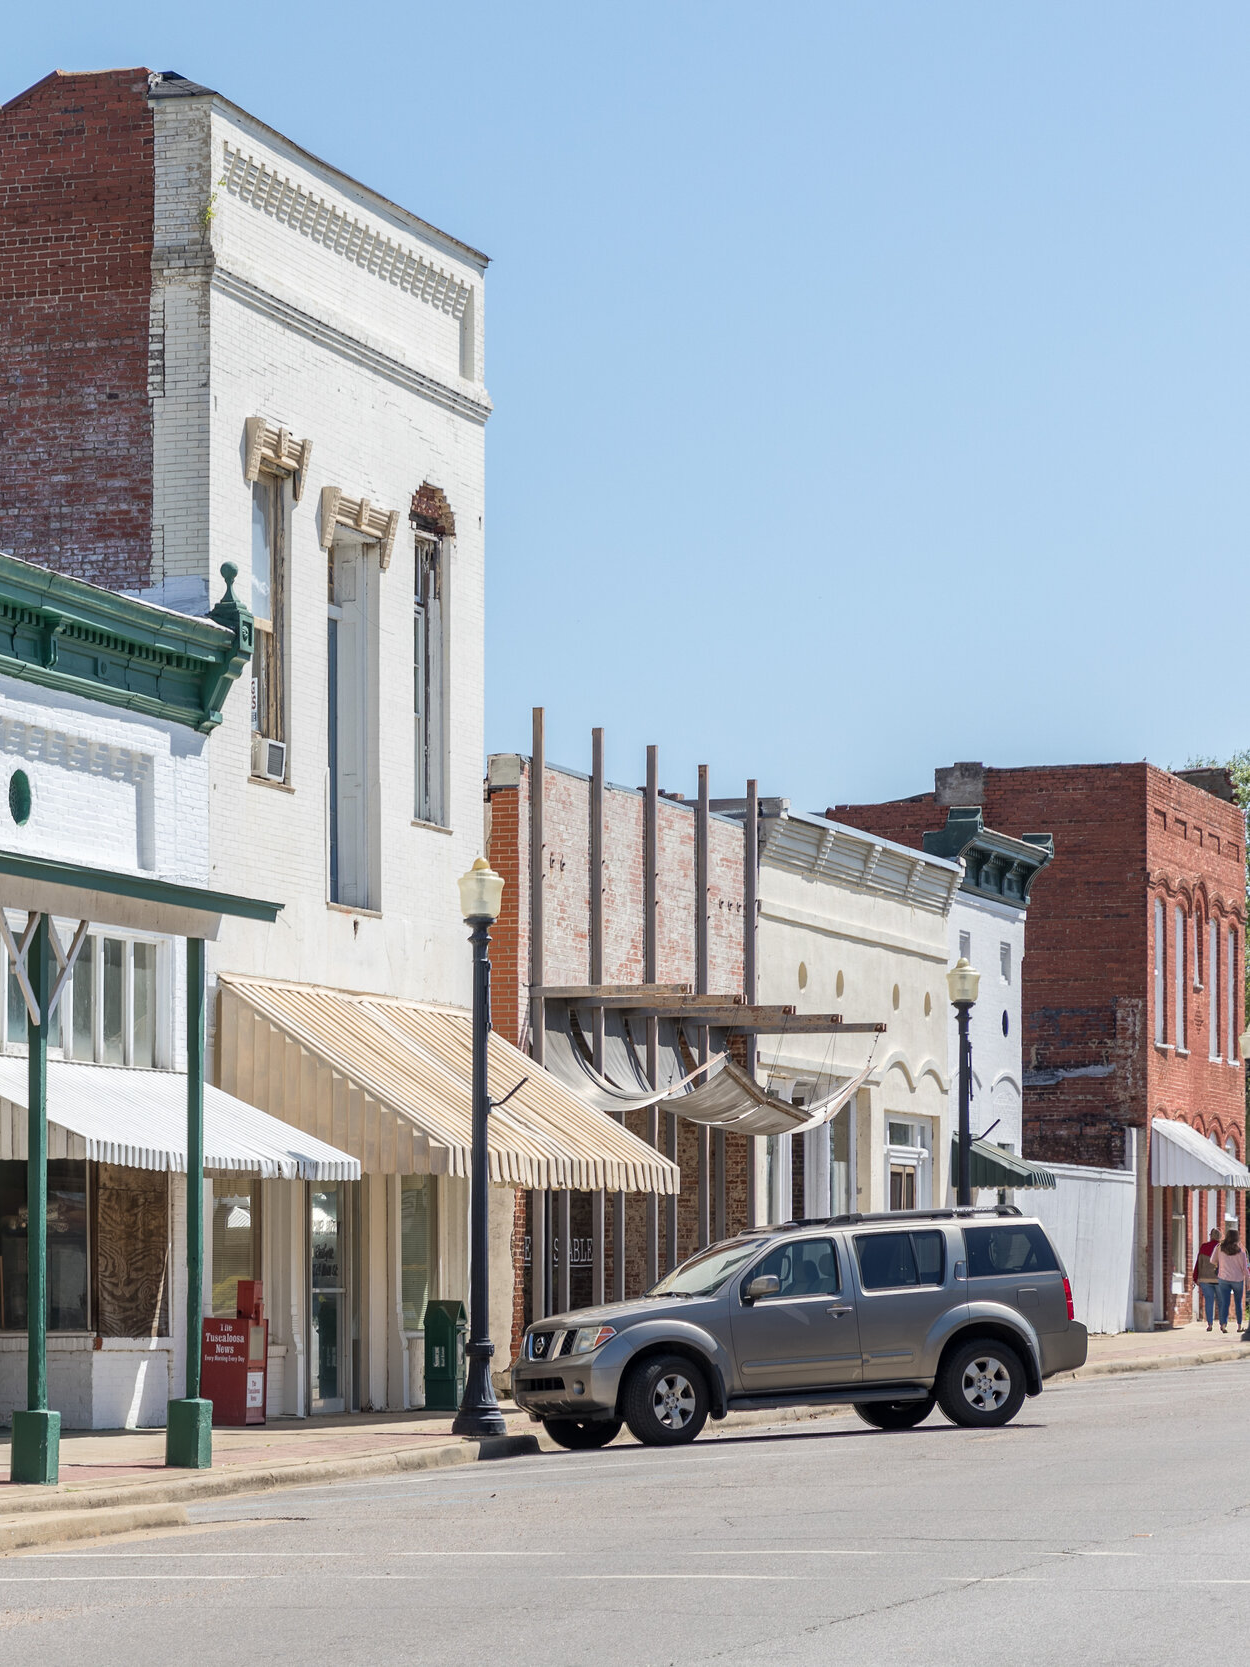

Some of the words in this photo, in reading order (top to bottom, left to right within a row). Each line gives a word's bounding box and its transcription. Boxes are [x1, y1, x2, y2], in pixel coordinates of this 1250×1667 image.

[553, 1237, 593, 1262] SABLE
[220, 1323, 233, 1332] The
[205, 1332, 245, 1343] Tuscaloosa
[215, 1343, 235, 1354] News
